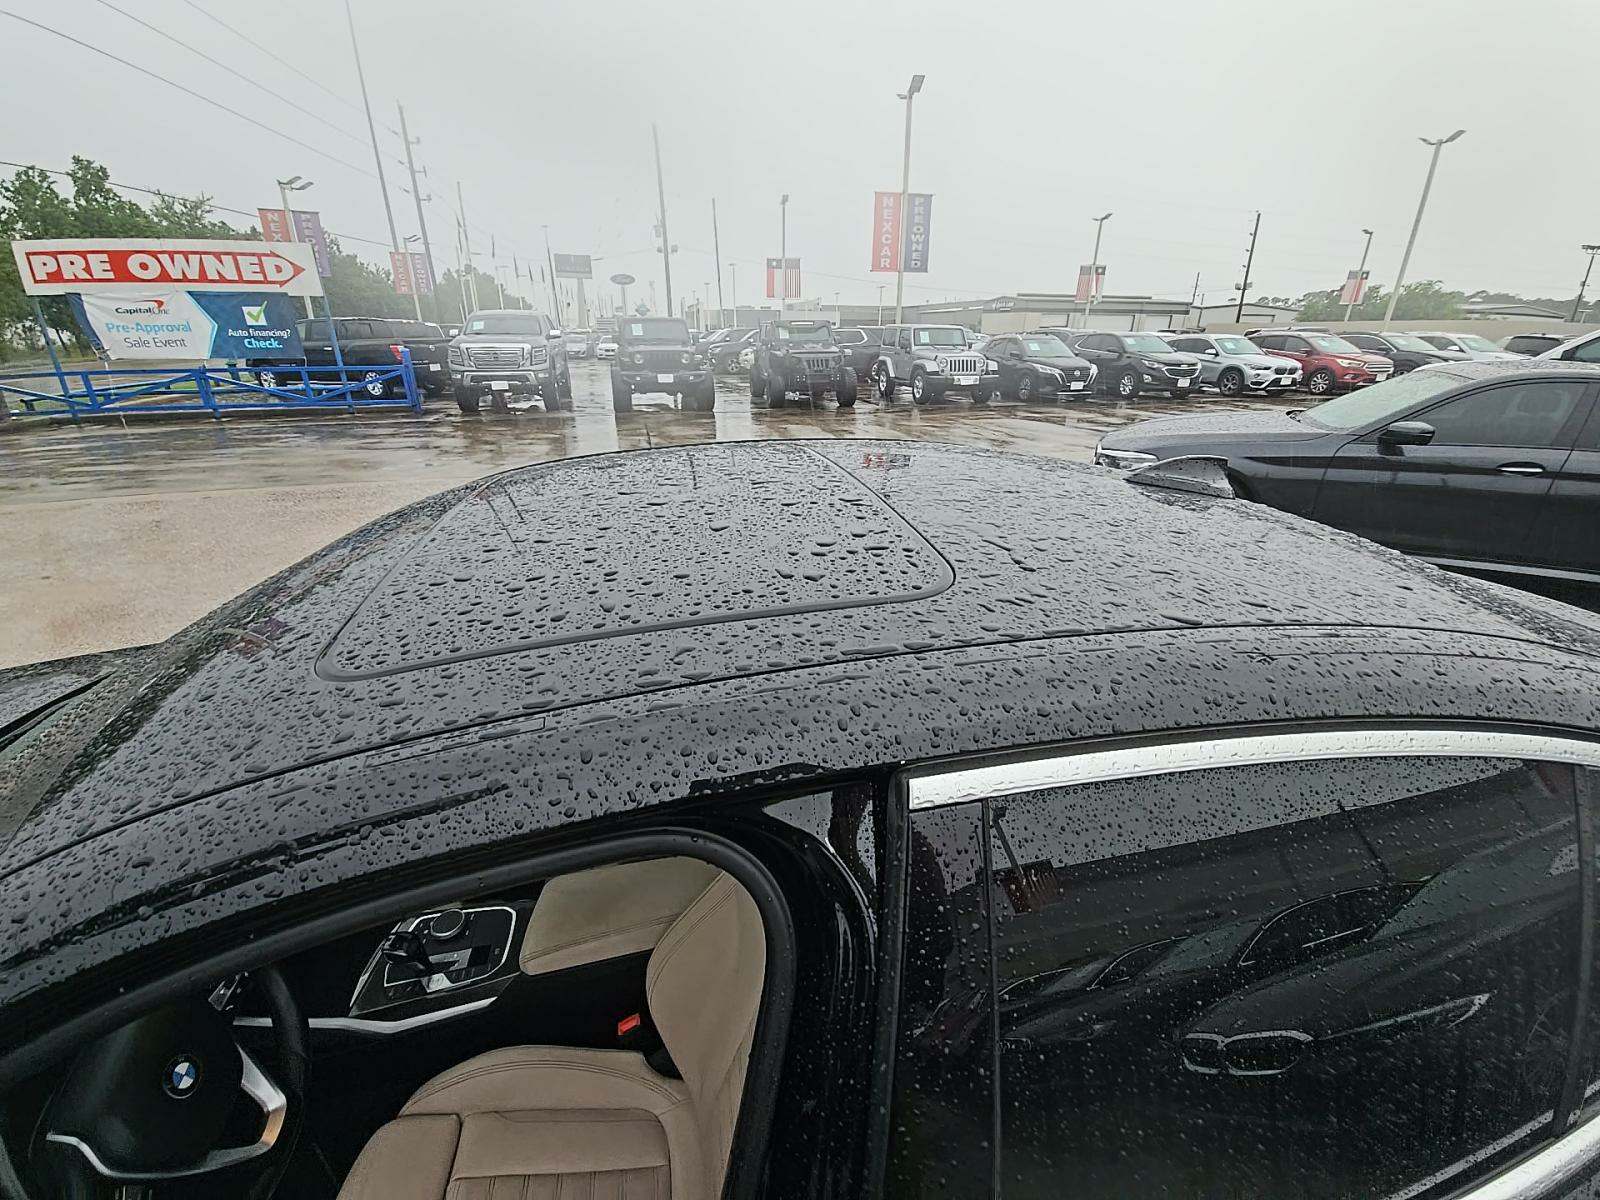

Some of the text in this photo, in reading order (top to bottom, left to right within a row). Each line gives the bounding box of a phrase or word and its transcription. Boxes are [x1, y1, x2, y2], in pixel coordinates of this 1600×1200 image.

[266, 213, 283, 241] NEX
[880, 196, 894, 268] NEXCAR
[910, 197, 925, 268] PREOWNED
[28, 253, 294, 282] PRE OWNED
[105, 321, 192, 335] Pre-Approval
[228, 328, 291, 339] Auto financing?
[124, 336, 188, 348] Sale Event
[243, 338, 283, 349] Check.
